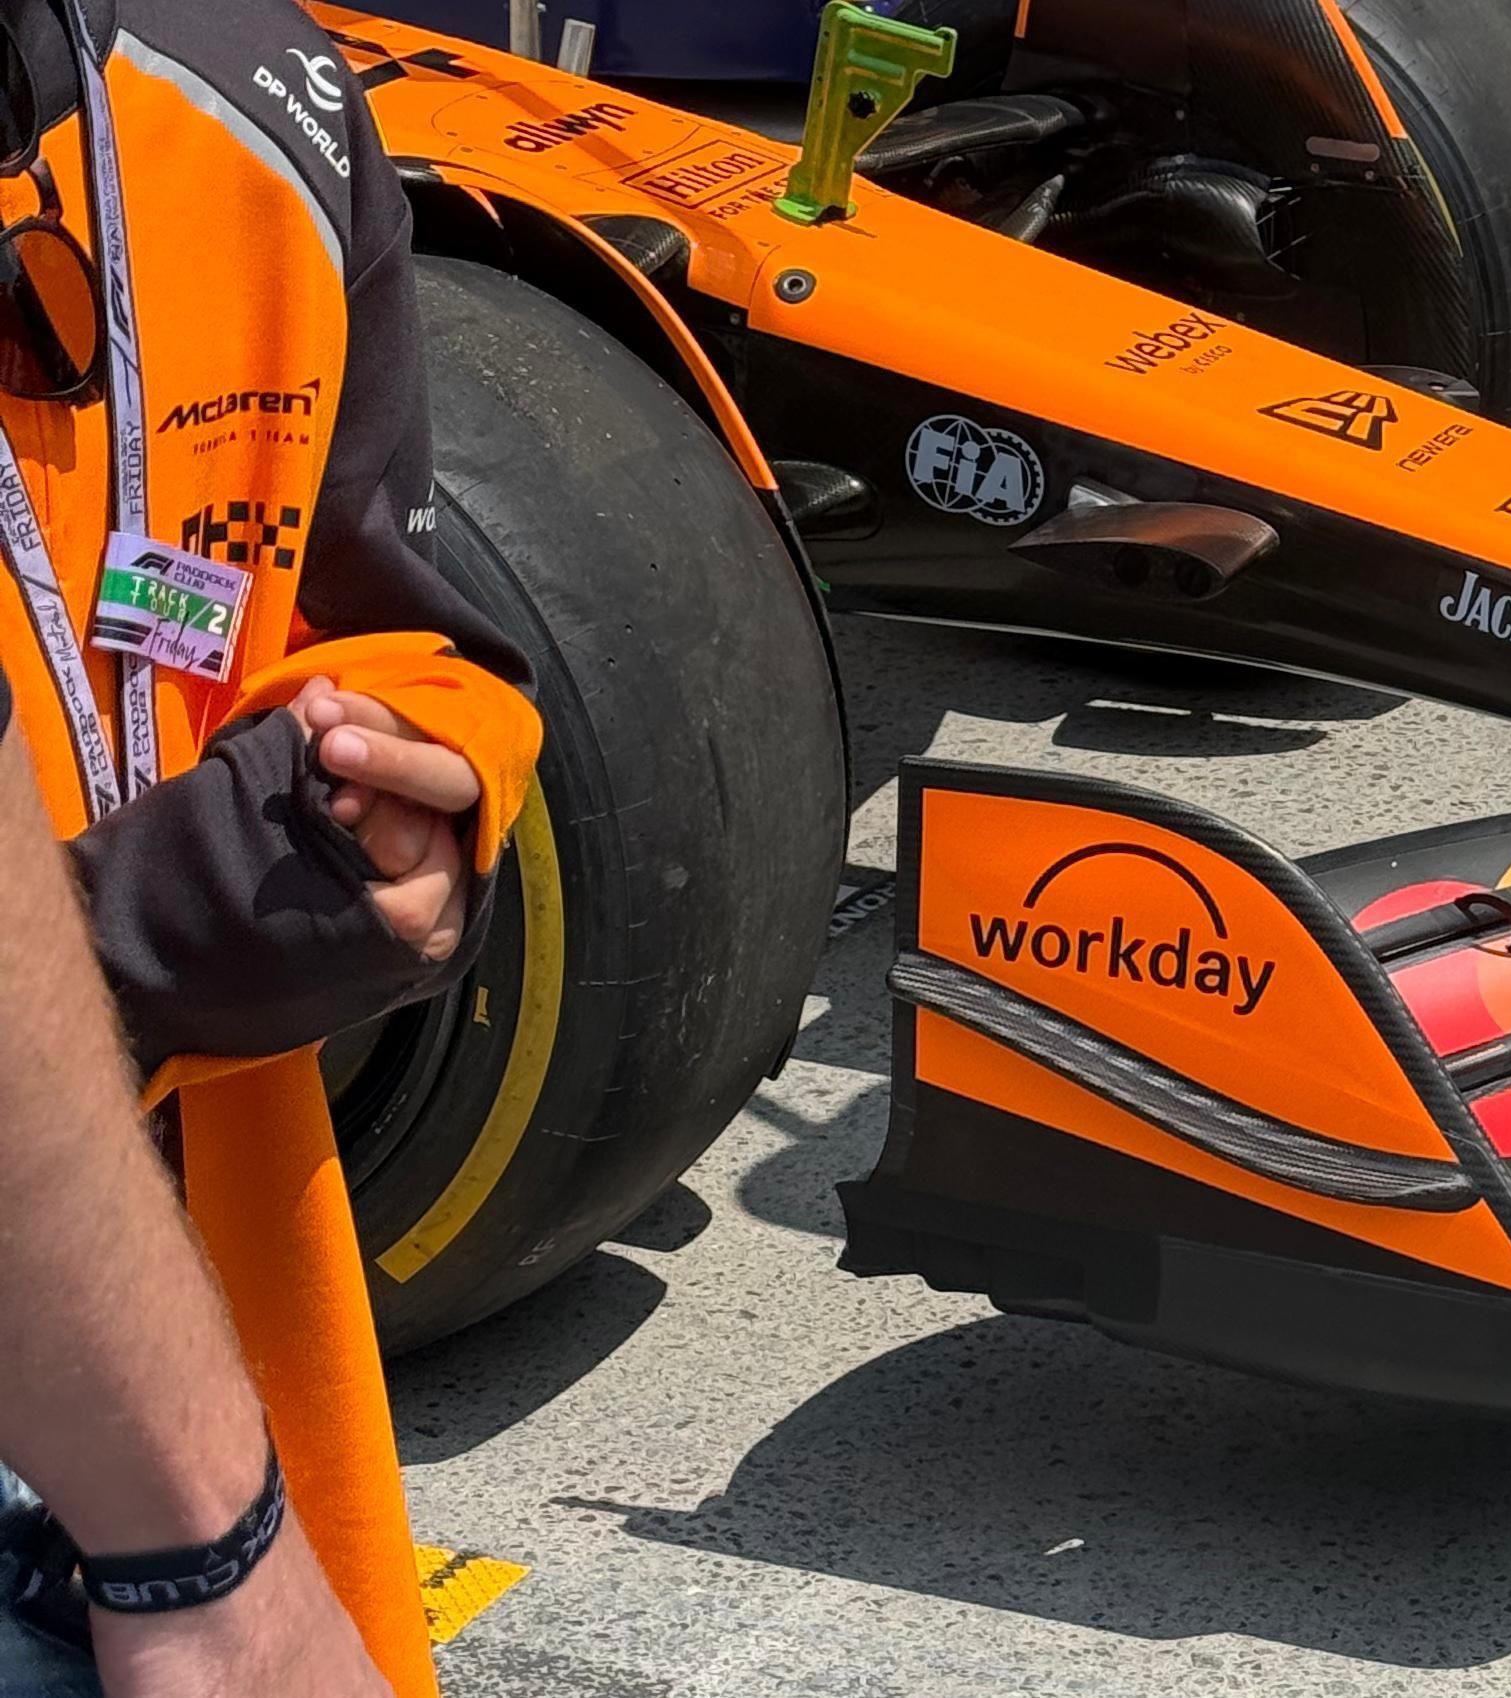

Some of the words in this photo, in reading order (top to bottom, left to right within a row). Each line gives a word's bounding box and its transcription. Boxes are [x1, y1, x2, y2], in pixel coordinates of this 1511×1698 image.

[253, 65, 286, 98] DP
[286, 94, 350, 177] WORLD
[503, 102, 636, 153] allwyn
[645, 151, 766, 200] Hilton
[1103, 311, 1227, 375] webex
[156, 385, 315, 434] McLaren
[127, 421, 143, 516] FRIDAY
[131, 575, 190, 610] TRACK
[174, 572, 206, 591] CLUB
[175, 561, 237, 591] PADDOCK
[149, 612, 201, 670] Friday
[206, 603, 228, 636] 2
[61, 666, 100, 778] PADDOCK
[129, 651, 143, 758] PADDOC
[138, 690, 150, 755] CLUB
[87, 712, 108, 773] CLUB
[970, 913, 1275, 1016] workday
[101, 1559, 240, 1603] CLUB
